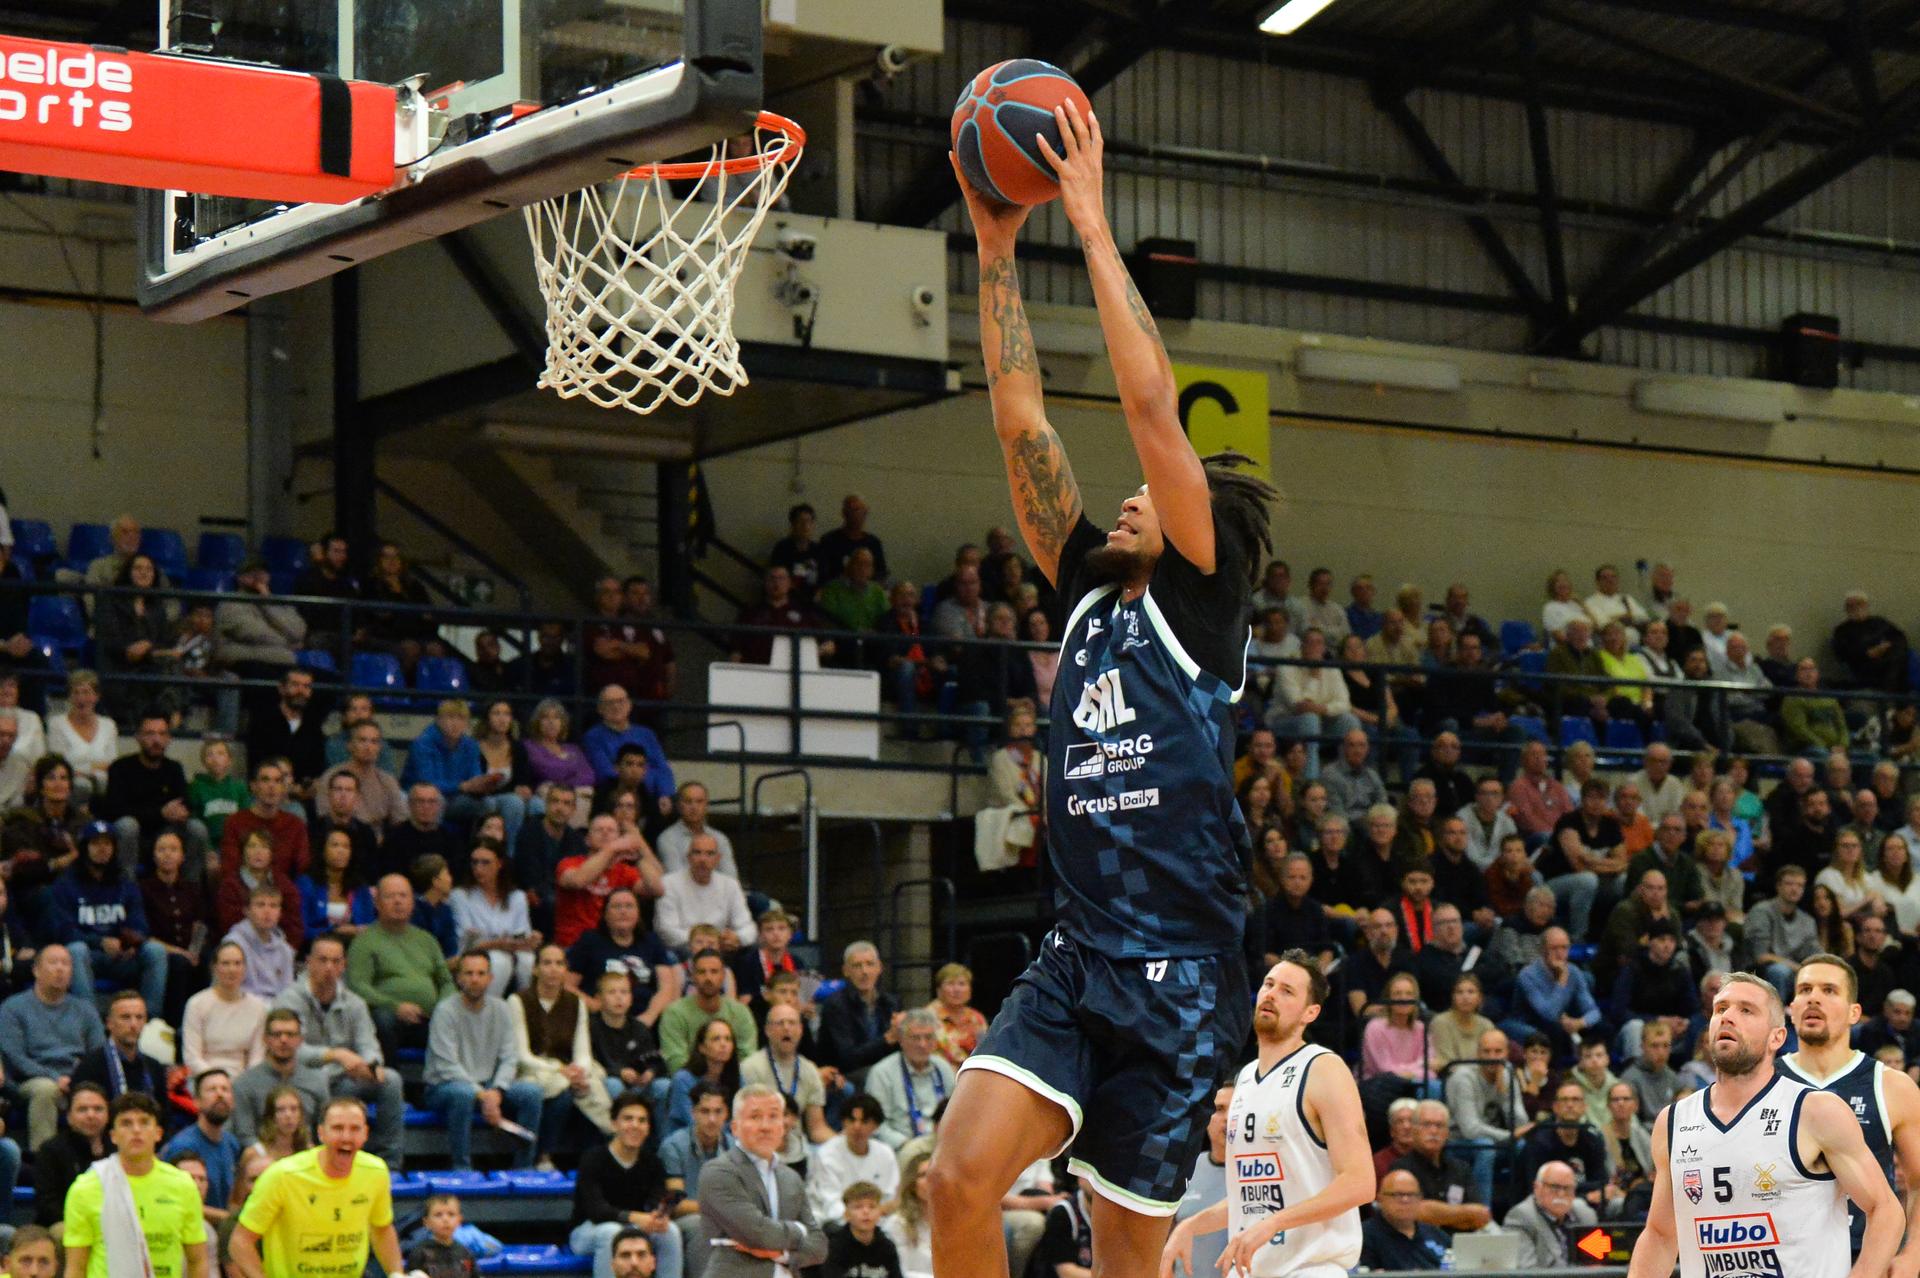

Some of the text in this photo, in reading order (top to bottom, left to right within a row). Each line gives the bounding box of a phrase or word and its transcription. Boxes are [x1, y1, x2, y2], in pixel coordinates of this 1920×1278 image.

[0, 48, 133, 93] elde
[1178, 381, 1240, 442] C
[1103, 734, 1154, 759] BRG
[1107, 756, 1146, 773] GROUP
[1067, 792, 1154, 816] Circus Daily
[1145, 960, 1168, 982] 17
[1760, 1108, 1779, 1120] BN
[1765, 1120, 1782, 1132] XT
[1244, 1113, 1256, 1143] 9
[1713, 1166, 1733, 1203] 5
[1700, 1221, 1767, 1244] Hubo
